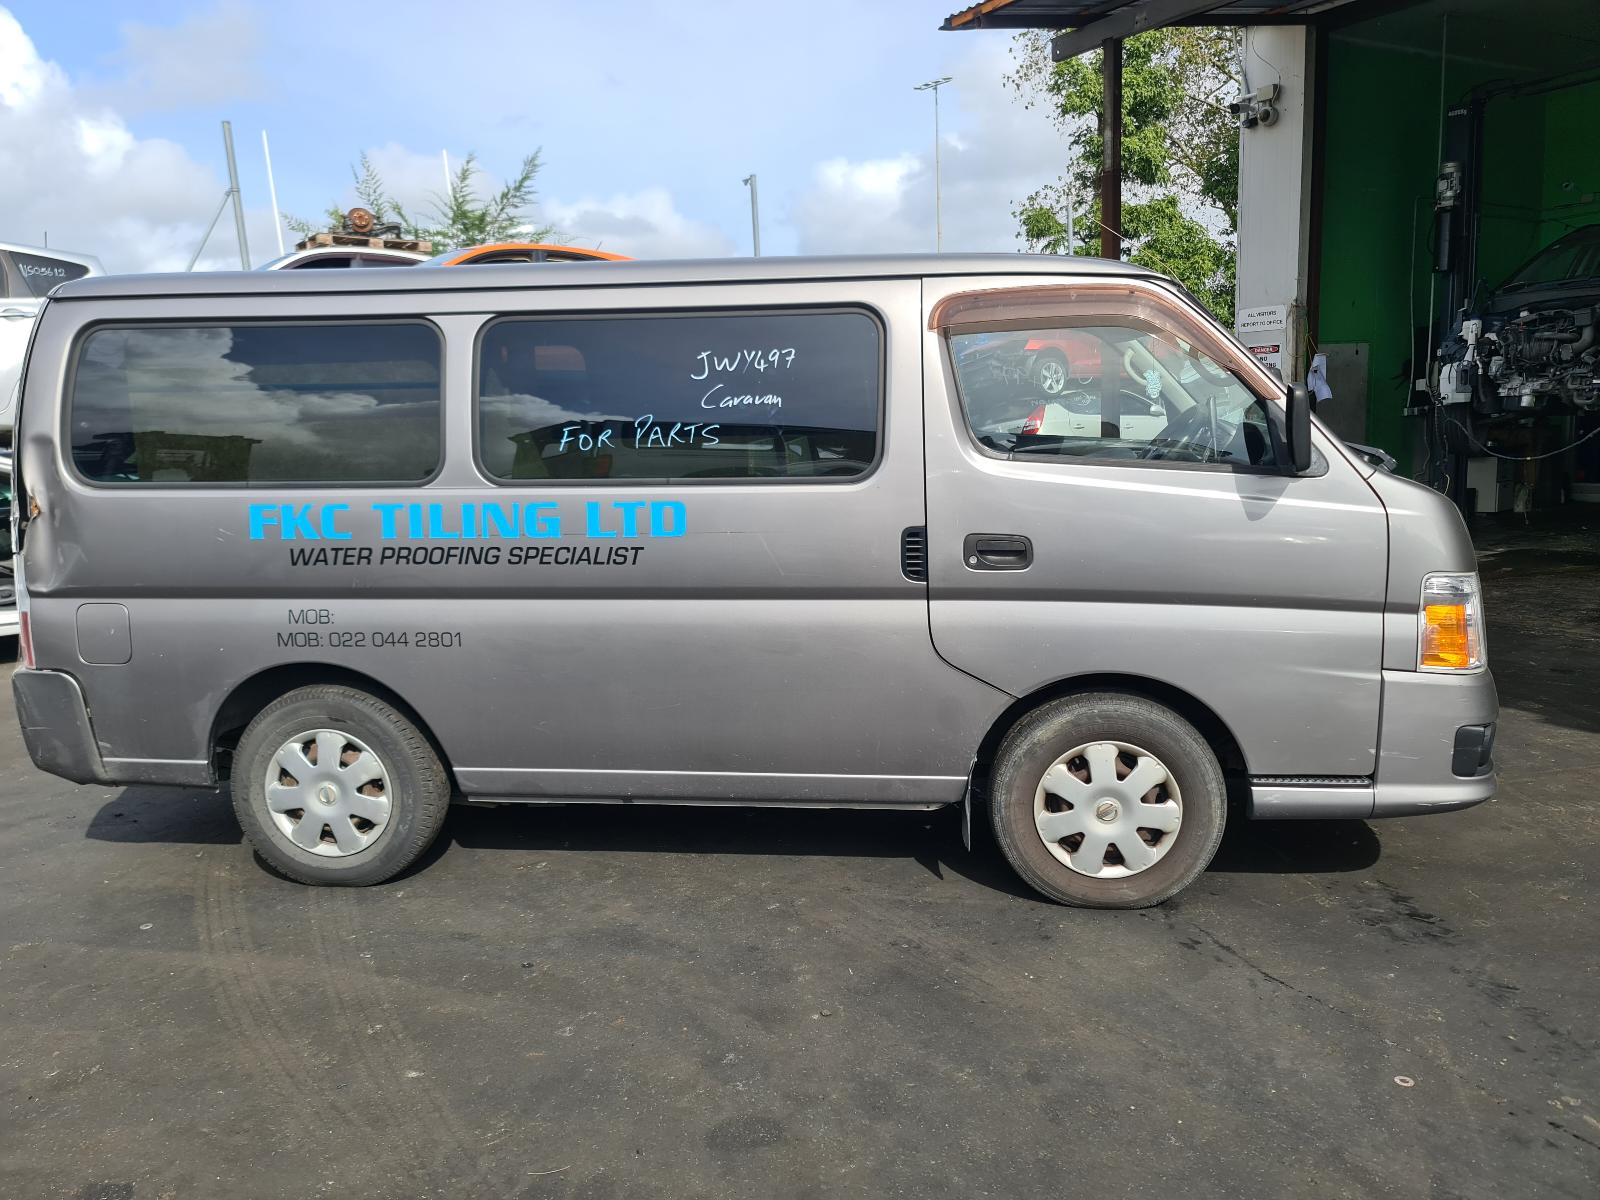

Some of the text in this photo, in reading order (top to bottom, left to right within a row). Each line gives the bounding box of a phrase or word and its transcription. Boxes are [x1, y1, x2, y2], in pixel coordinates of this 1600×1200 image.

[690, 348, 796, 380] JWY497
[701, 384, 782, 409] Caravan
[559, 414, 720, 452] FOR PARTS
[248, 500, 688, 540] FKC TILING LTD
[289, 546, 645, 566] WATER PROOFING SPECIALIST
[288, 608, 335, 625] MOB:
[277, 631, 463, 648] MOB: 022 044 2801
